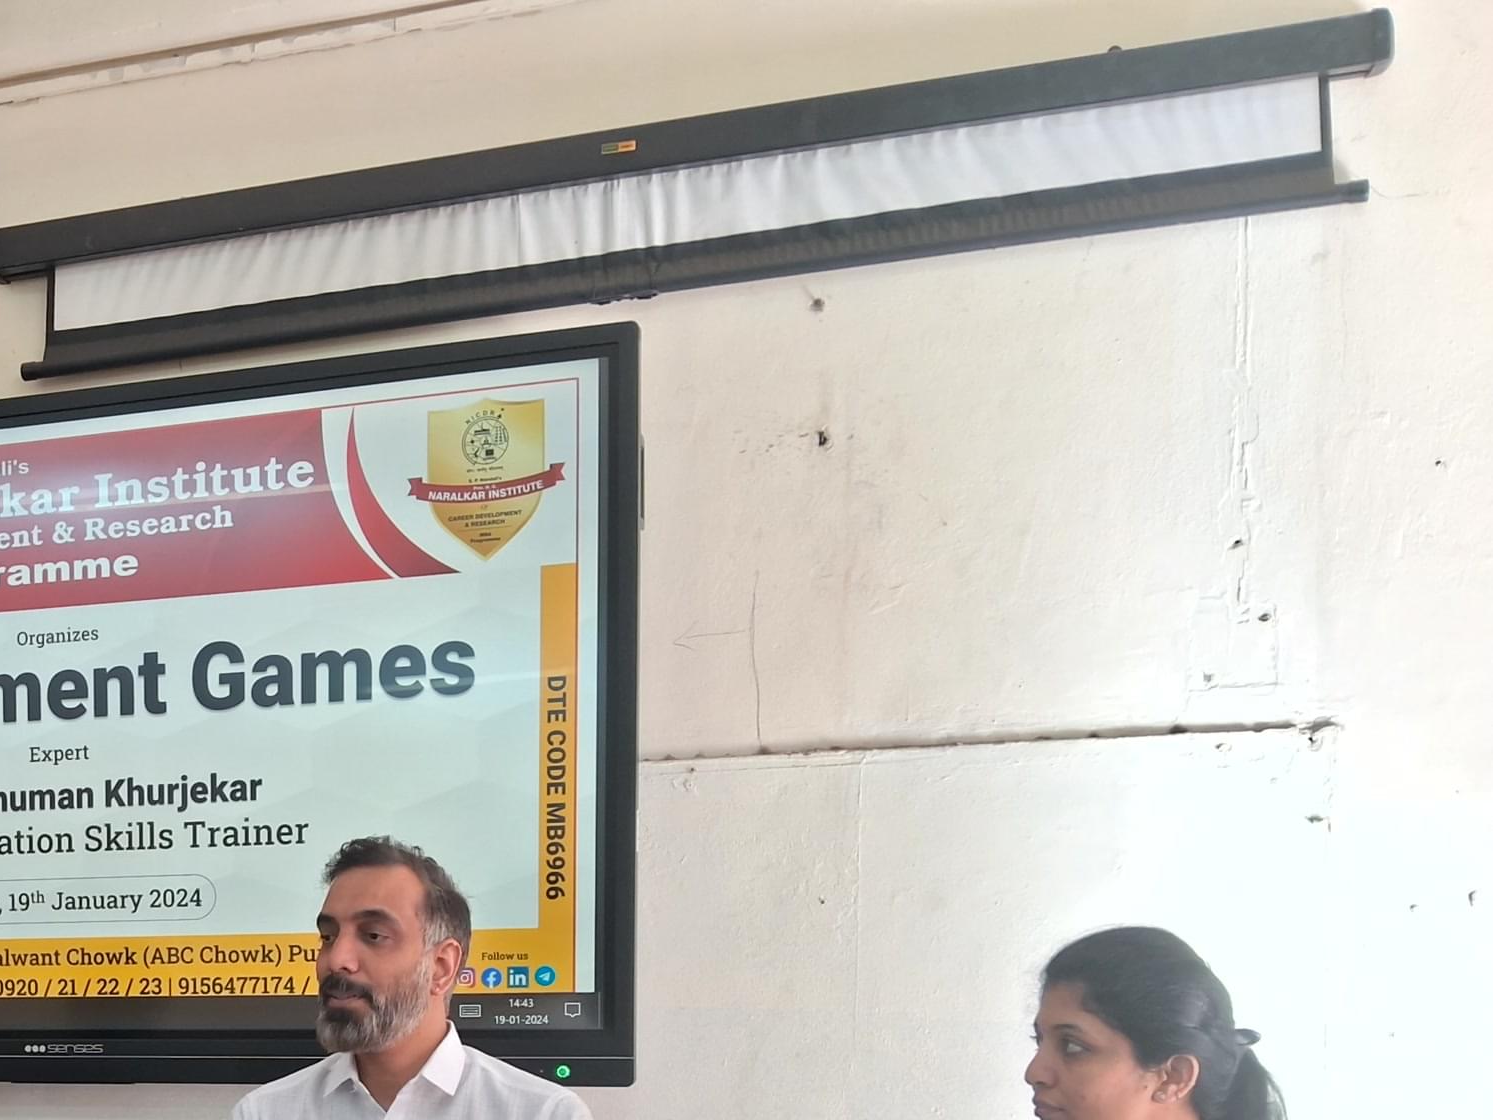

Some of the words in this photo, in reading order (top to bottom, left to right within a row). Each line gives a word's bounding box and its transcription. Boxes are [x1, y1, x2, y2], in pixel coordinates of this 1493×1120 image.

[94, 457, 314, 508] Institute
[428, 490, 485, 501] NARALKAR
[488, 480, 544, 499] INSTITUTE
[52, 521, 75, 543] &
[84, 505, 233, 541] Research
[17, 627, 99, 648] Organizes
[192, 640, 475, 711] Games
[547, 676, 567, 724] DTE
[29, 745, 89, 765] Expert
[547, 729, 566, 796] CODE
[104, 773, 262, 812] Khurjekar
[84, 820, 174, 852] Skills
[184, 818, 309, 848] Trainer
[546, 802, 566, 900] MB6966
[8, 890, 45, 911] 19th
[51, 889, 143, 914] January
[149, 887, 202, 908] 2024
[66, 947, 137, 966] Chowk
[143, 945, 193, 968] (ABC
[200, 944, 282, 967] Chowk)
[481, 952, 515, 961] Follow
[516, 952, 528, 960] us
[58, 979, 77, 996] 21
[97, 978, 120, 995] 22
[139, 978, 162, 995] 23
[178, 976, 295, 994] 9156477174
[508, 998, 534, 1008] 14:43
[494, 1015, 548, 1025] 19-01-2024
